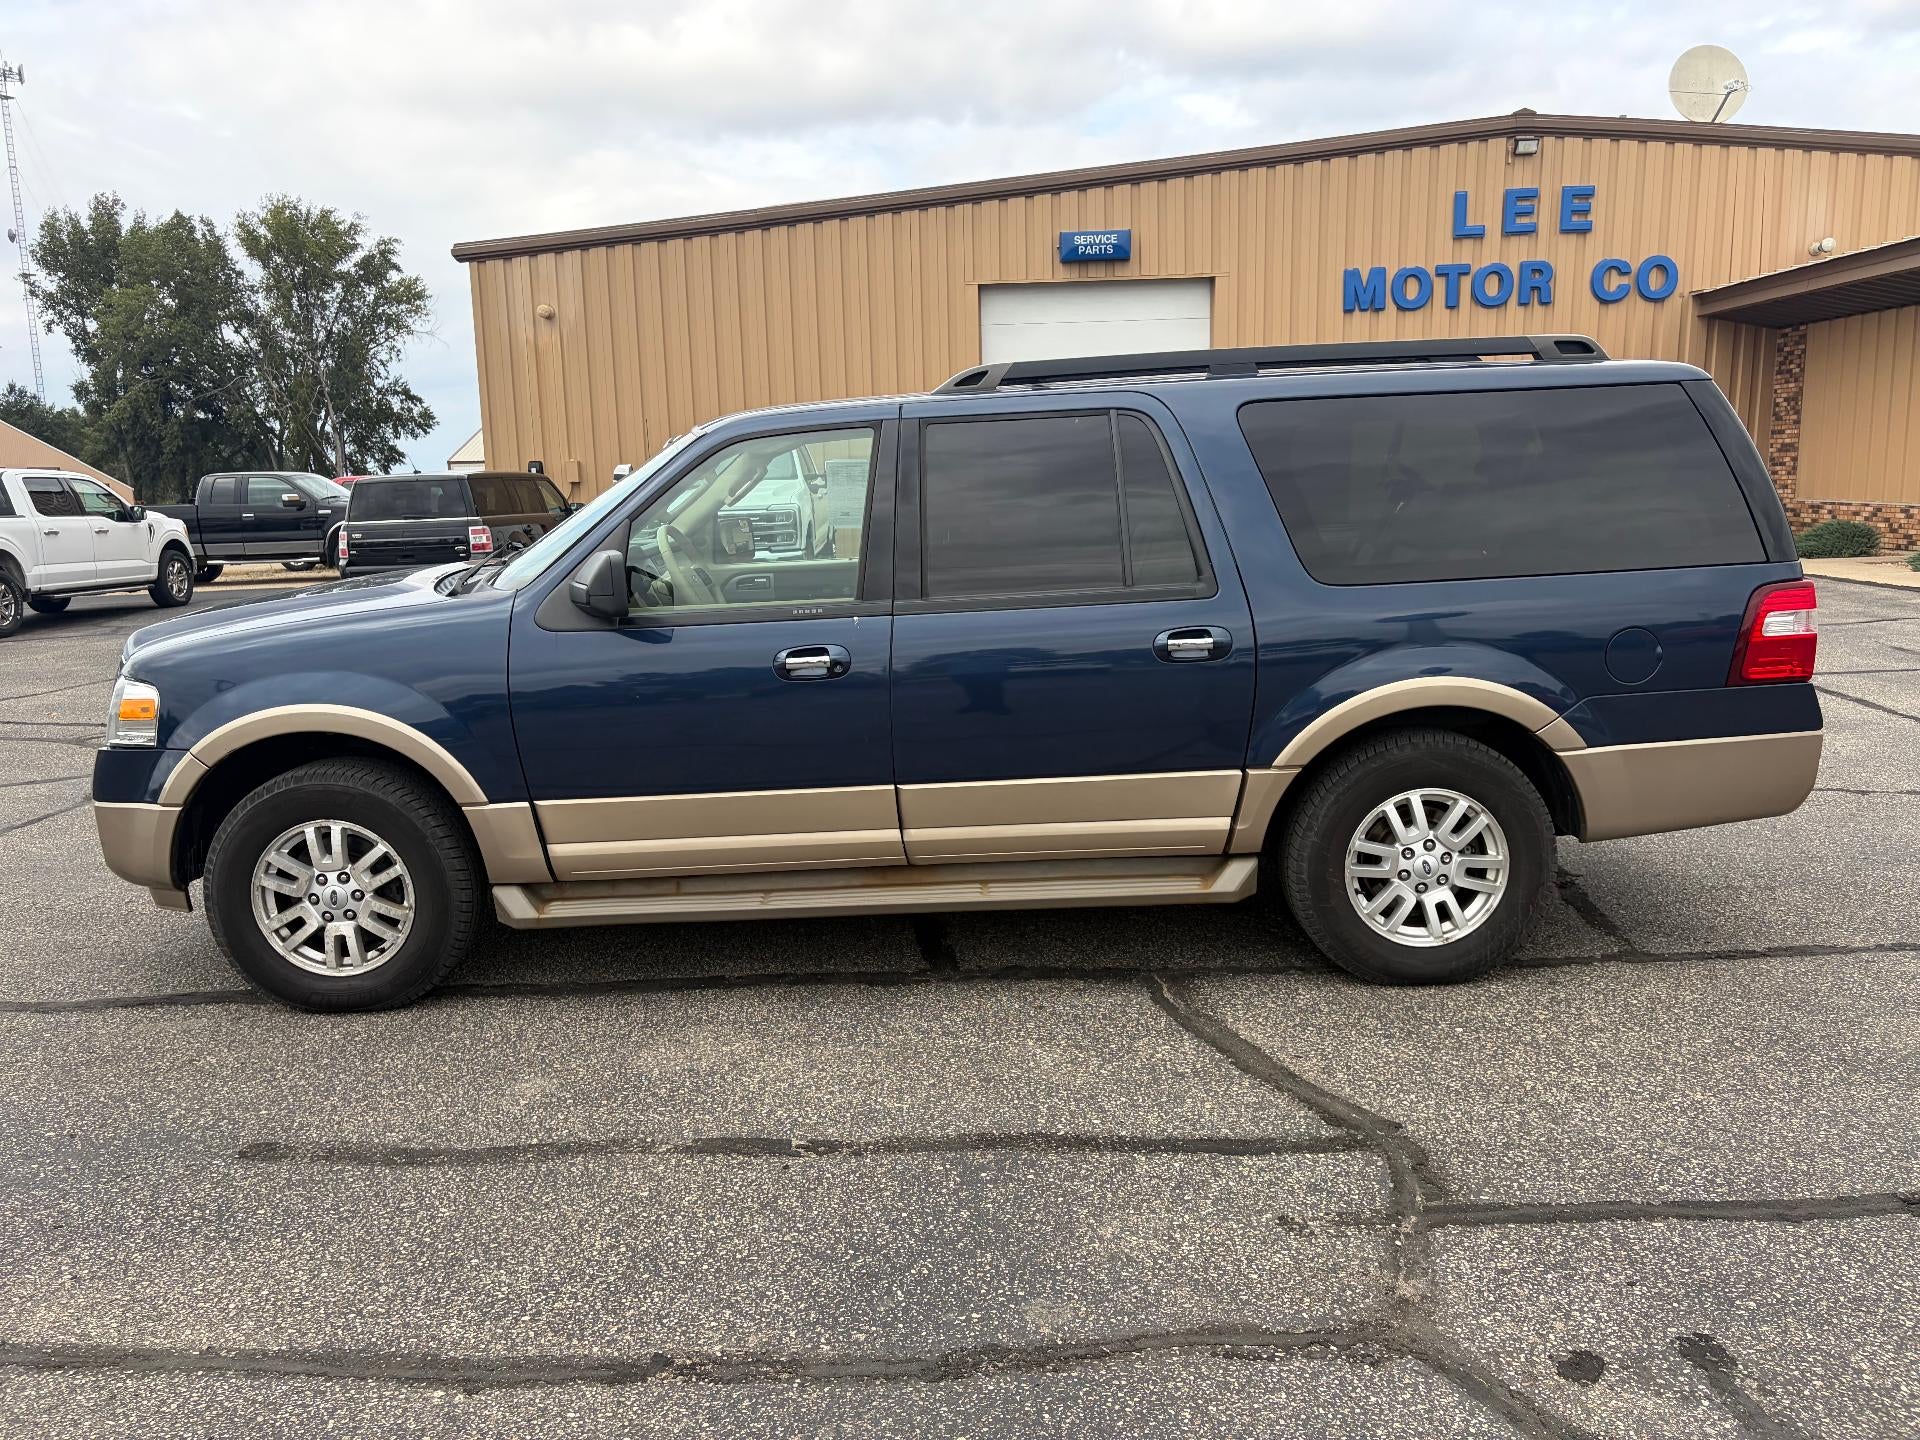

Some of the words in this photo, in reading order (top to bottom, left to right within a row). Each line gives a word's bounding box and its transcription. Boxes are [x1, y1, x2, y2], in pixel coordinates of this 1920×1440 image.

[1453, 185, 1595, 238] LEE
[1074, 234, 1118, 244] SERVICE
[1078, 245, 1114, 255] PARTS
[1343, 260, 1554, 313] MOTOR
[1590, 254, 1679, 304] CO
